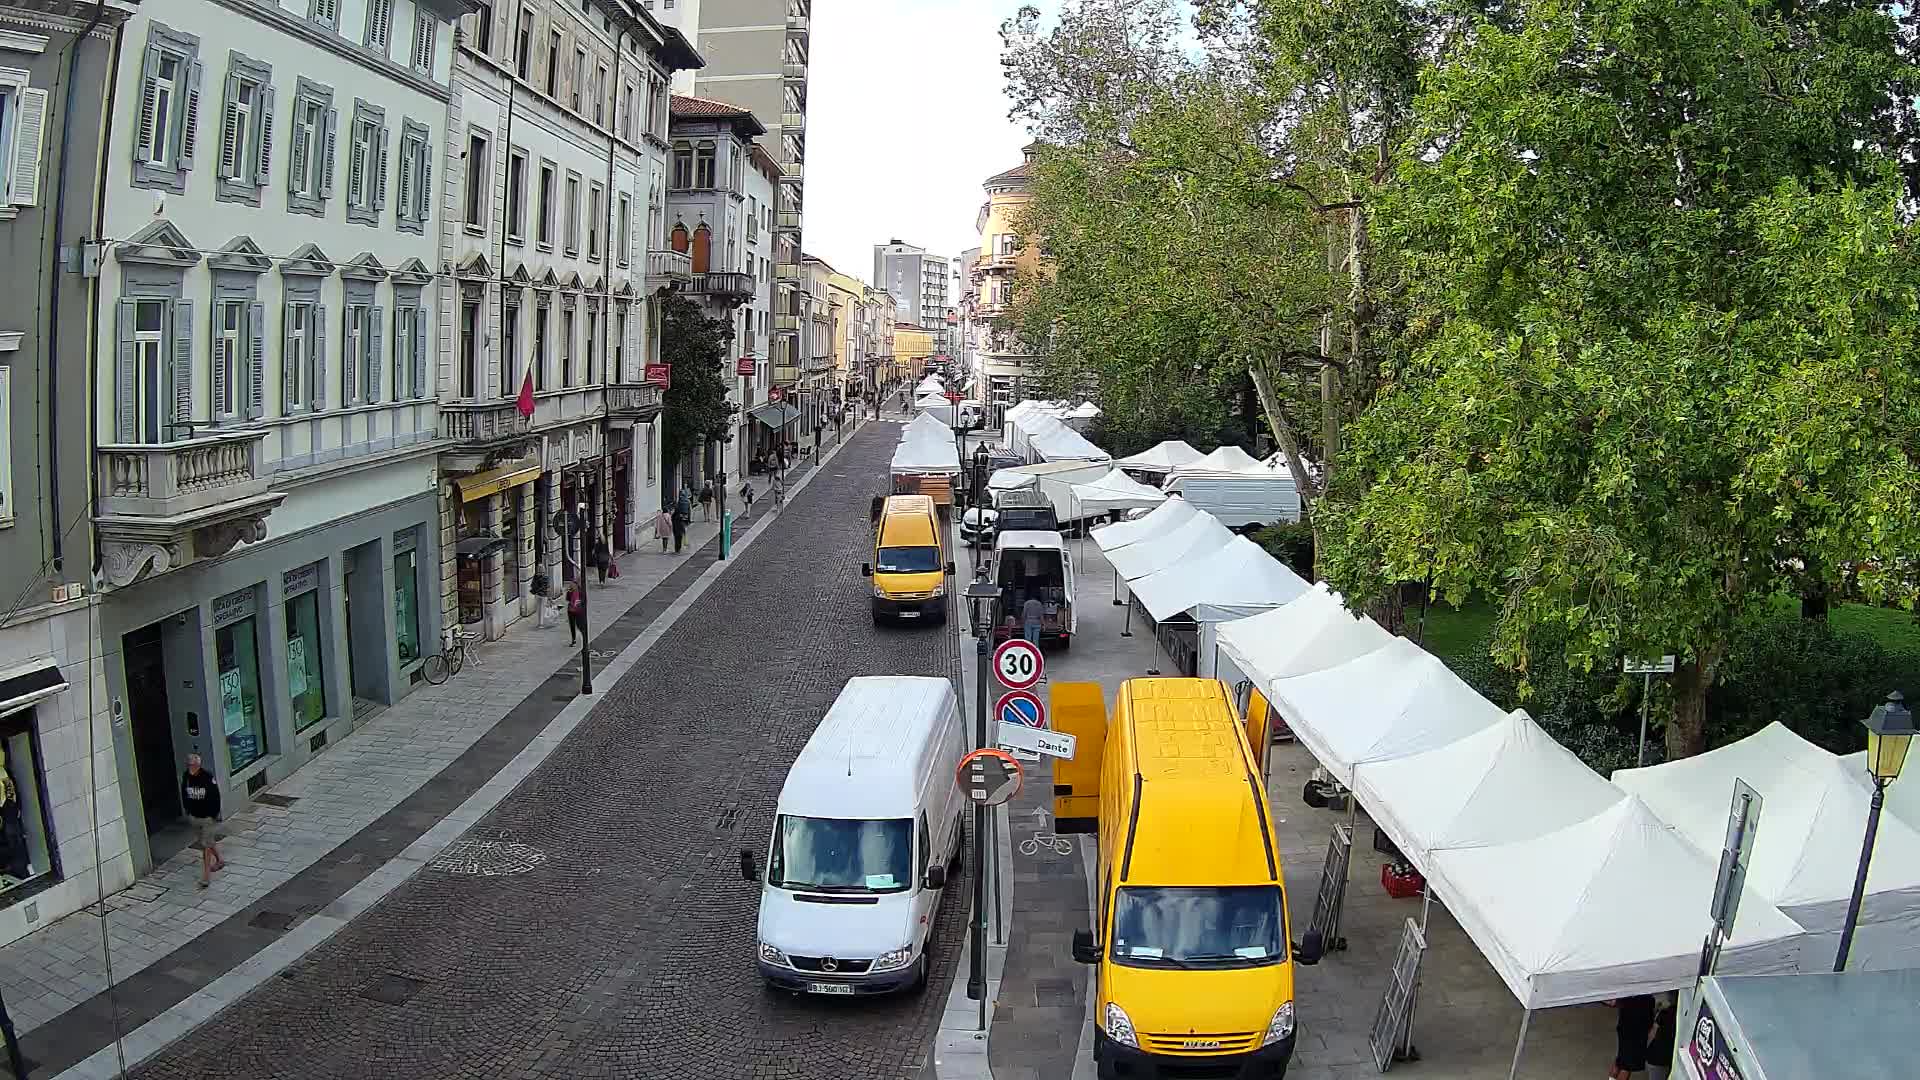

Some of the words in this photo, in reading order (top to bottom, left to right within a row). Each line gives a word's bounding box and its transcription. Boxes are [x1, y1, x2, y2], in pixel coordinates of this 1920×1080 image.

[1005, 654, 1032, 675] 30
[221, 672, 239, 695] 130
[1037, 740, 1068, 753] Dante
